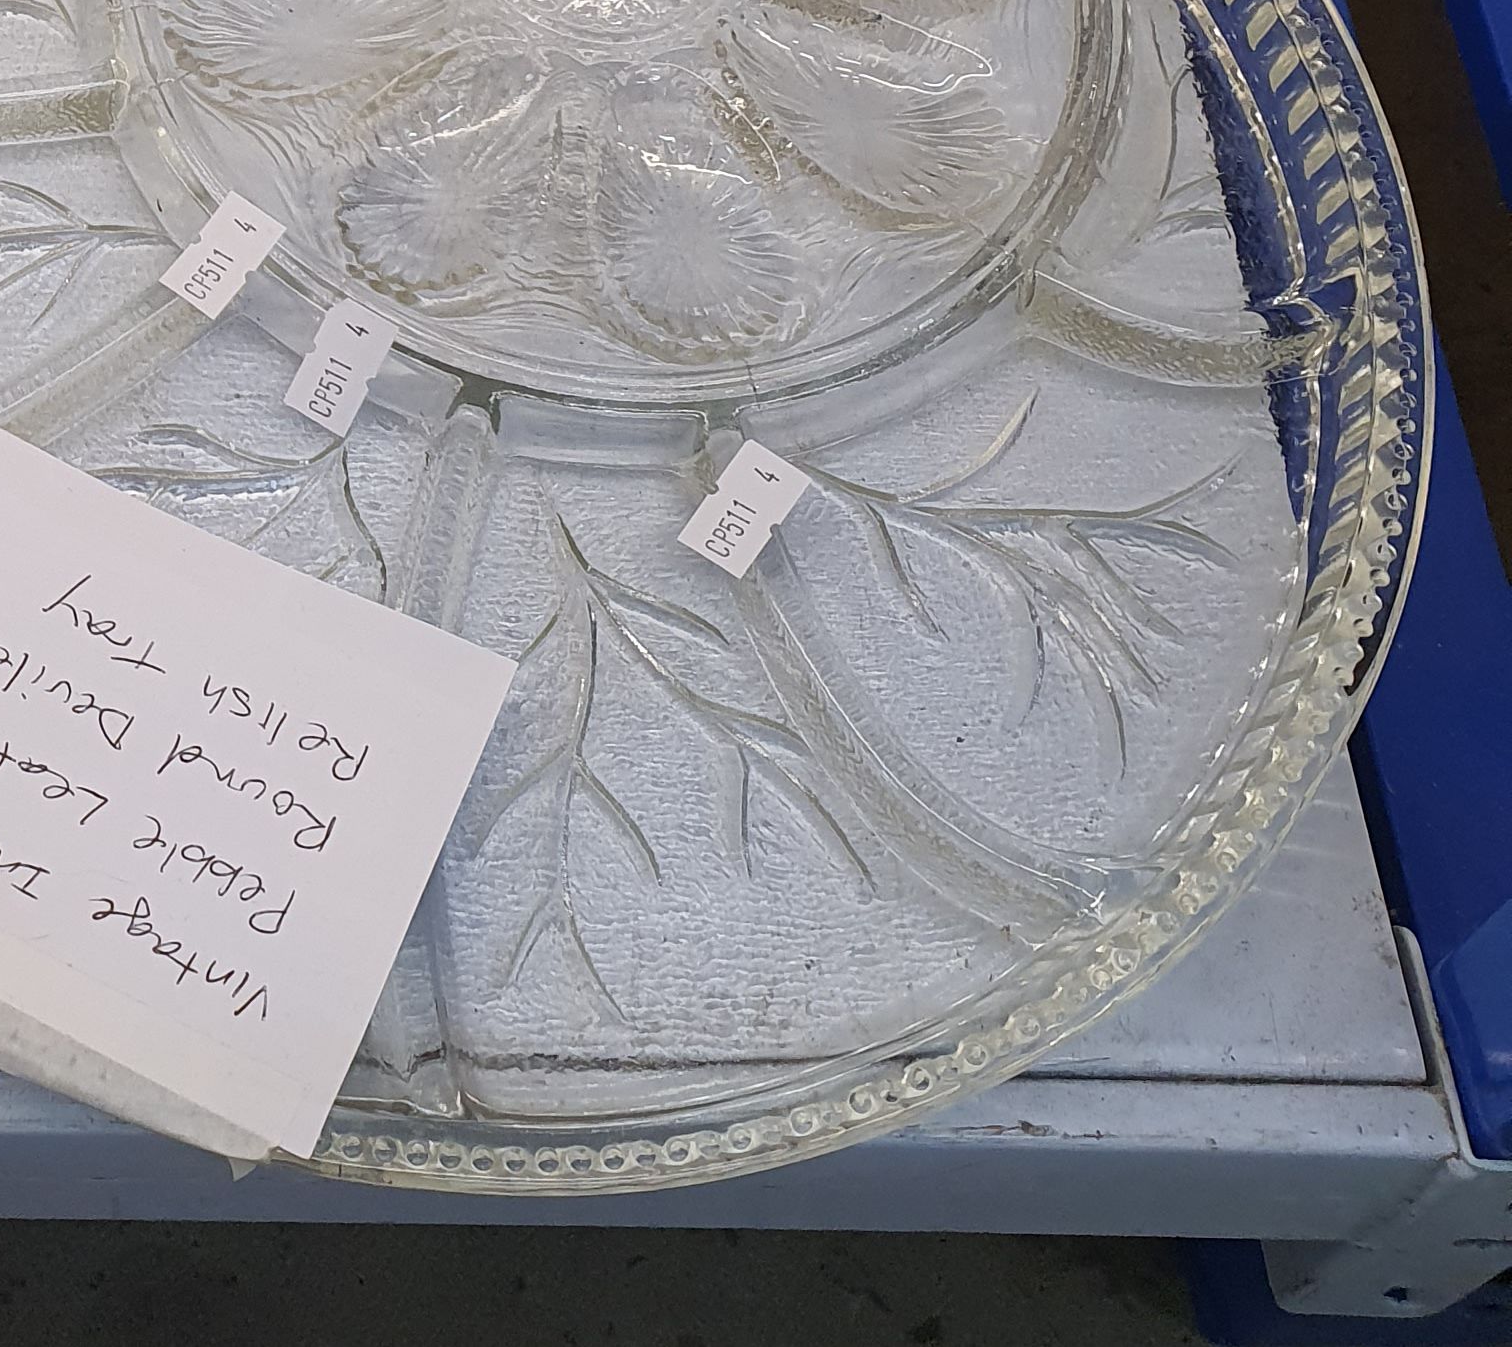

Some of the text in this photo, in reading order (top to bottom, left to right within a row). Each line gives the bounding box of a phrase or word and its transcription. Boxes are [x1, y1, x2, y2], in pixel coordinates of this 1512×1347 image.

[233, 218, 257, 233] 4
[308, 322, 370, 418] CP511 4
[704, 467, 780, 558] CP511 4
[203, 674, 370, 781] Relish
[157, 734, 337, 853] Round
[133, 814, 296, 935] Pebble
[89, 897, 268, 1022] Vintage
